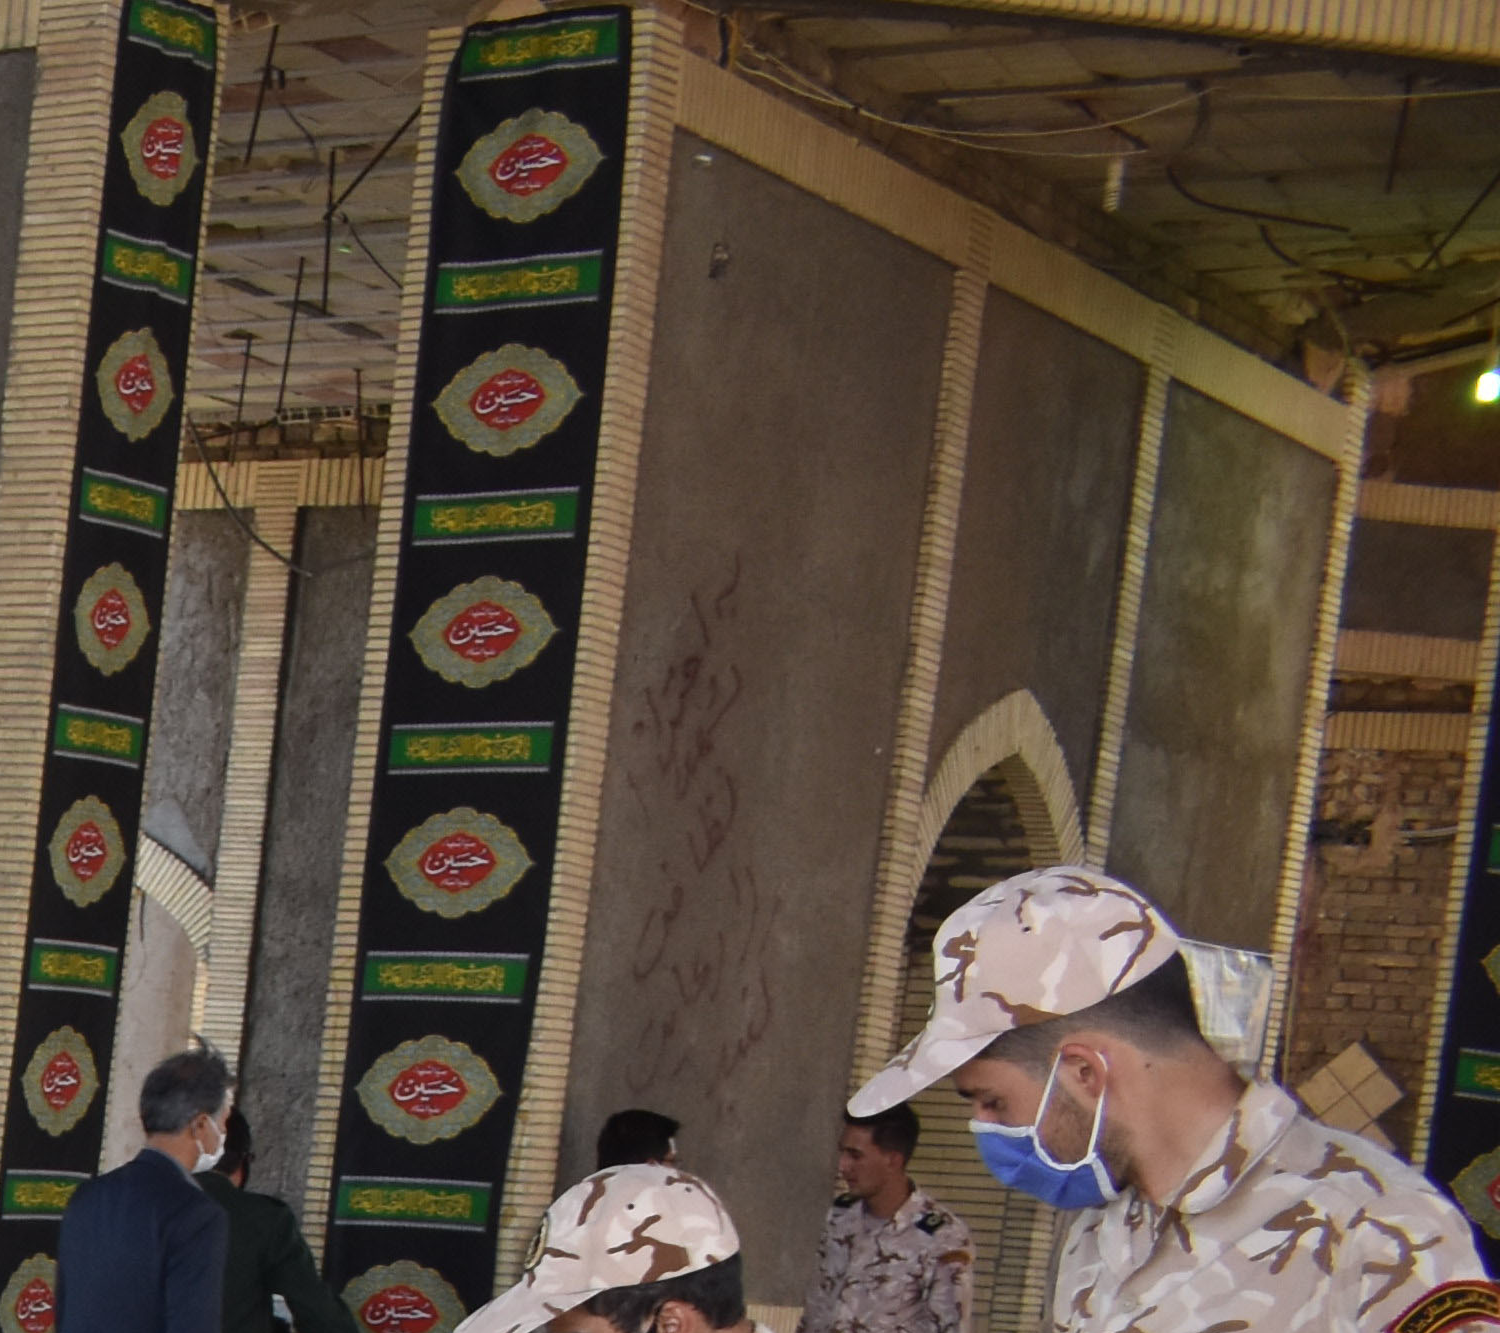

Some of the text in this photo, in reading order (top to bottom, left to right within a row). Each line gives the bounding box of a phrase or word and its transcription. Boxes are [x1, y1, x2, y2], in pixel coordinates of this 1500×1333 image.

[449, 617, 514, 644] حسین
[425, 849, 489, 875] حسین
[394, 1077, 460, 1101] حسین
